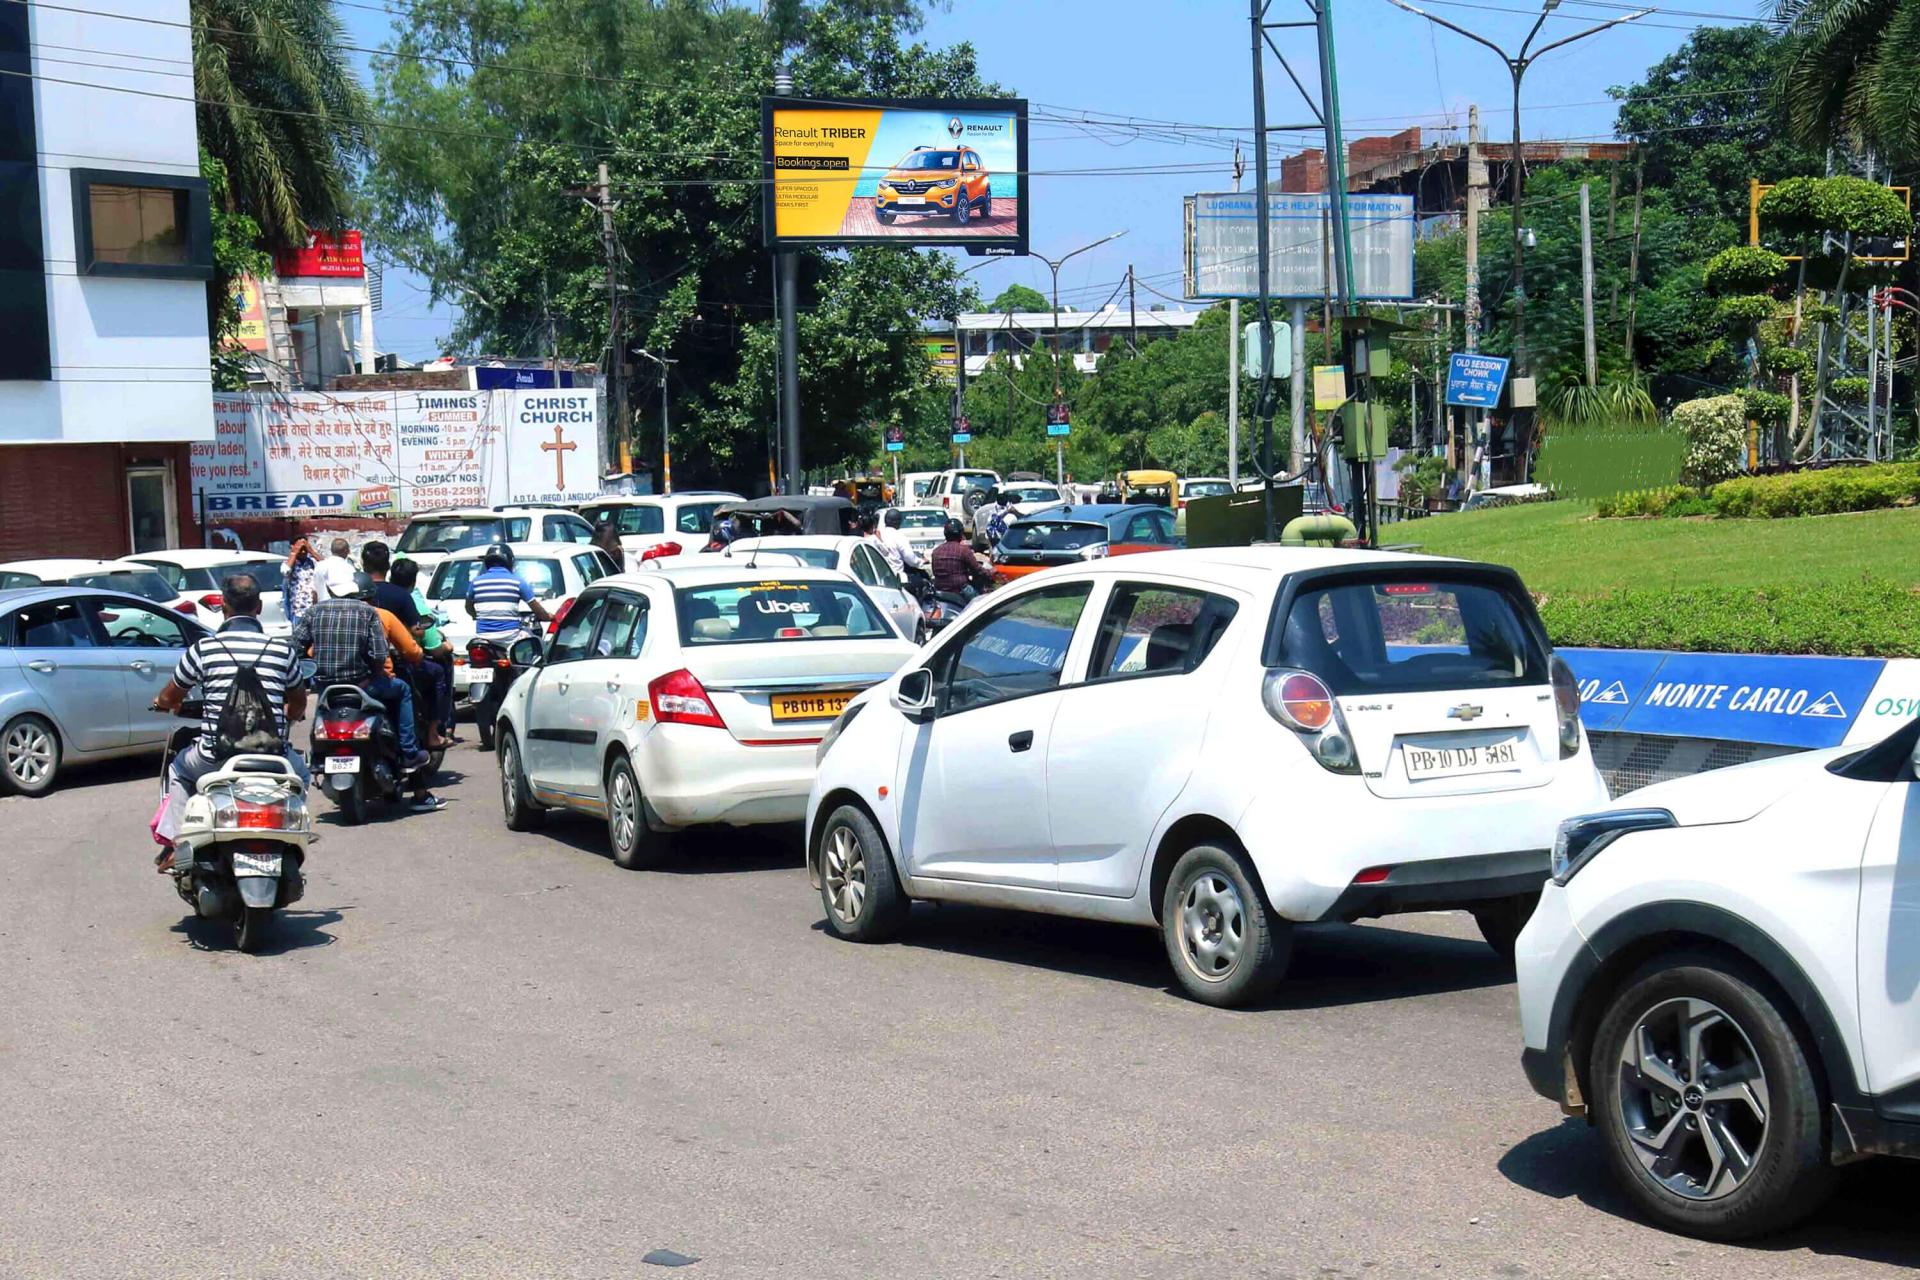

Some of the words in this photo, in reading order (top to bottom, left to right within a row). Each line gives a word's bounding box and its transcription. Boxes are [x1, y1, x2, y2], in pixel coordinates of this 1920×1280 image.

[774, 127, 818, 138] Renault
[821, 128, 866, 139] TRIBER
[774, 140, 795, 148] Space
[777, 157, 821, 170] Bookings
[823, 160, 848, 170] open
[1206, 201, 1254, 210] LUDHIANA
[1291, 201, 1315, 210] HELP
[1455, 359, 1471, 367] OLD
[1471, 360, 1502, 370] SESSION
[1463, 368, 1490, 378] CHOWK
[230, 400, 252, 413] unto
[417, 398, 477, 409] TIMINGS
[524, 398, 588, 410] CHRIST
[430, 412, 473, 421] SUMMER
[520, 411, 593, 424] CHURCH
[216, 420, 247, 434] labour
[401, 424, 440, 434] MORNING
[401, 437, 438, 446] EVENING
[447, 437, 452, 445] 5
[192, 444, 215, 459] eavy
[429, 451, 468, 460] WINTER
[191, 462, 206, 477] ive
[209, 465, 226, 480] you
[420, 463, 428, 471] 11
[415, 475, 457, 484] CONTACT
[460, 474, 478, 482] NOS
[208, 493, 344, 511] BREAD
[360, 490, 388, 502] KITTY
[756, 600, 810, 613] Uber
[1645, 682, 1729, 709] MONTE
[1728, 686, 1809, 716] CARLO
[1456, 746, 1478, 767] DJ
